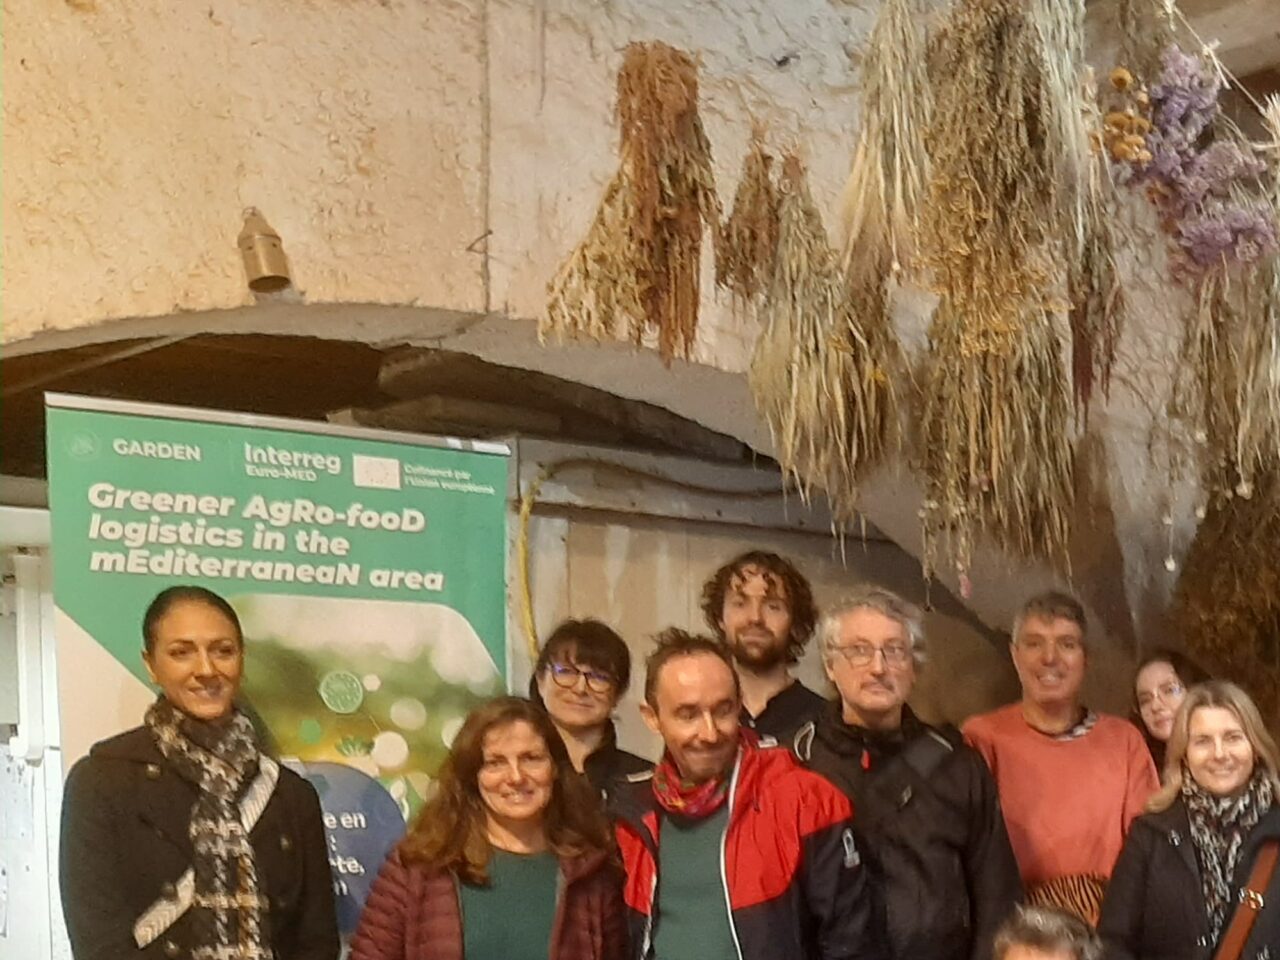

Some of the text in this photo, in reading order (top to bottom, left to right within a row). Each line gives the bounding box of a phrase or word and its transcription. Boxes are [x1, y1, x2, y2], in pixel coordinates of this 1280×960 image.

[113, 438, 201, 461] GARDEN
[245, 442, 341, 474] Interreg
[246, 465, 317, 482] Euro-MED
[88, 482, 425, 533] Greener AgRo-fooD
[89, 513, 350, 555] logistics in the
[89, 548, 444, 591] mEditerraneaN area
[340, 812, 367, 829] en
